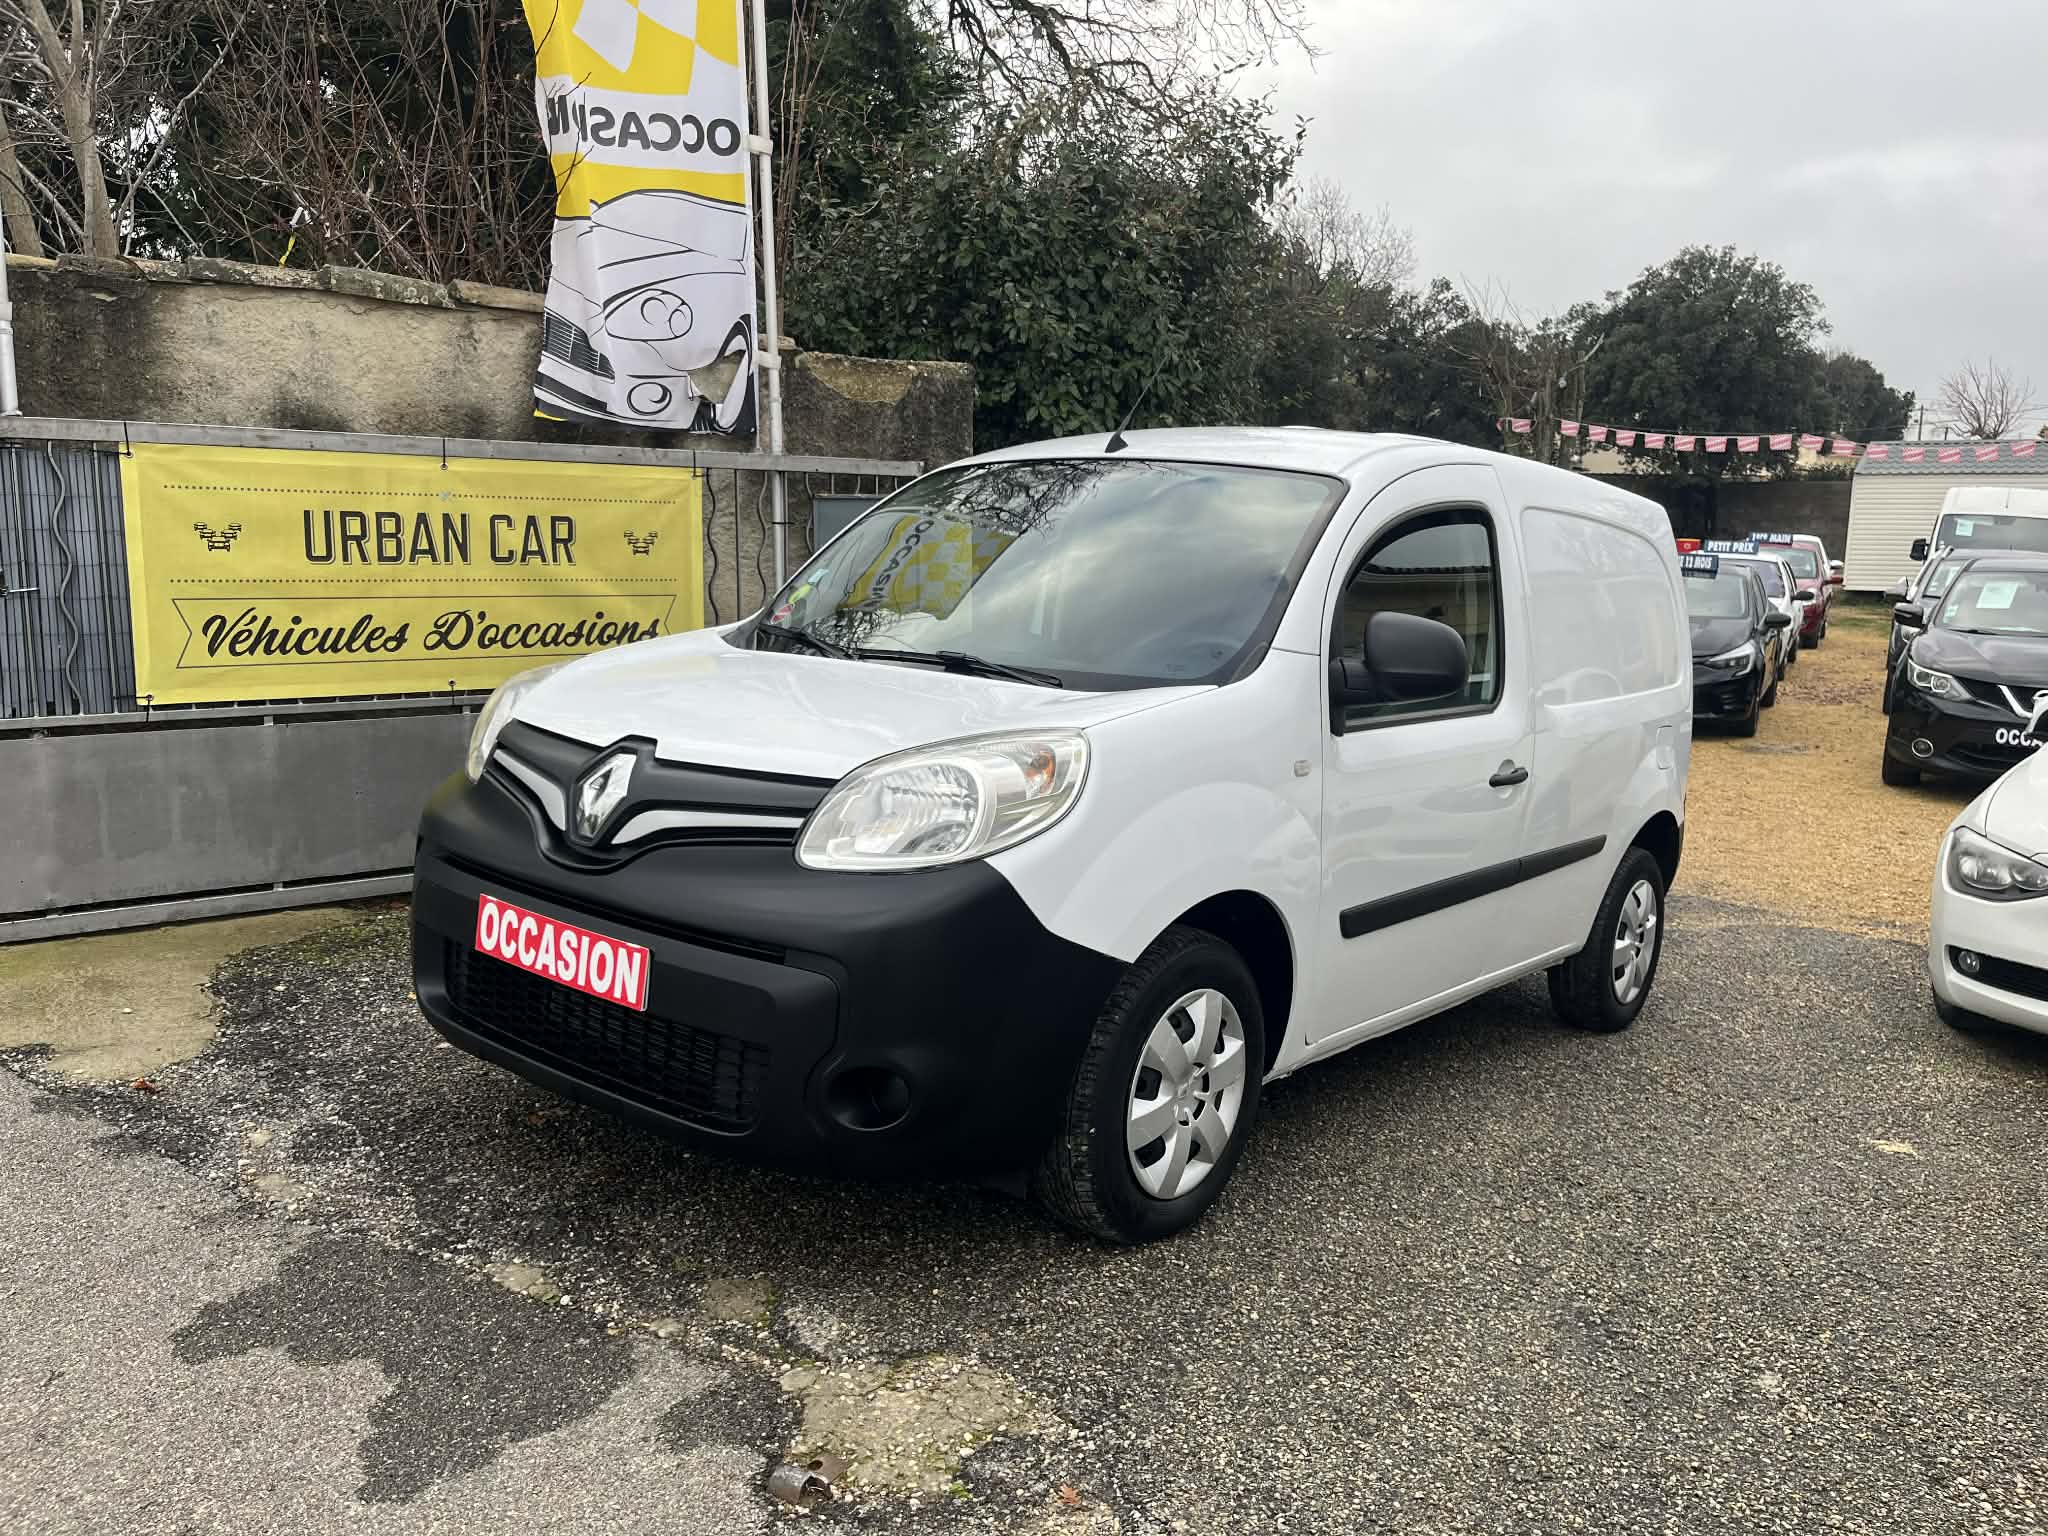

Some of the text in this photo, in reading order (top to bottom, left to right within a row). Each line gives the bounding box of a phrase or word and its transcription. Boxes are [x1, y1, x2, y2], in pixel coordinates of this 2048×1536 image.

[303, 509, 577, 565] URBAN CAR
[1707, 541, 1754, 553] PETIT PRIX
[202, 607, 660, 658] Véhicules D'occasions
[480, 902, 642, 1004] OCCASION
